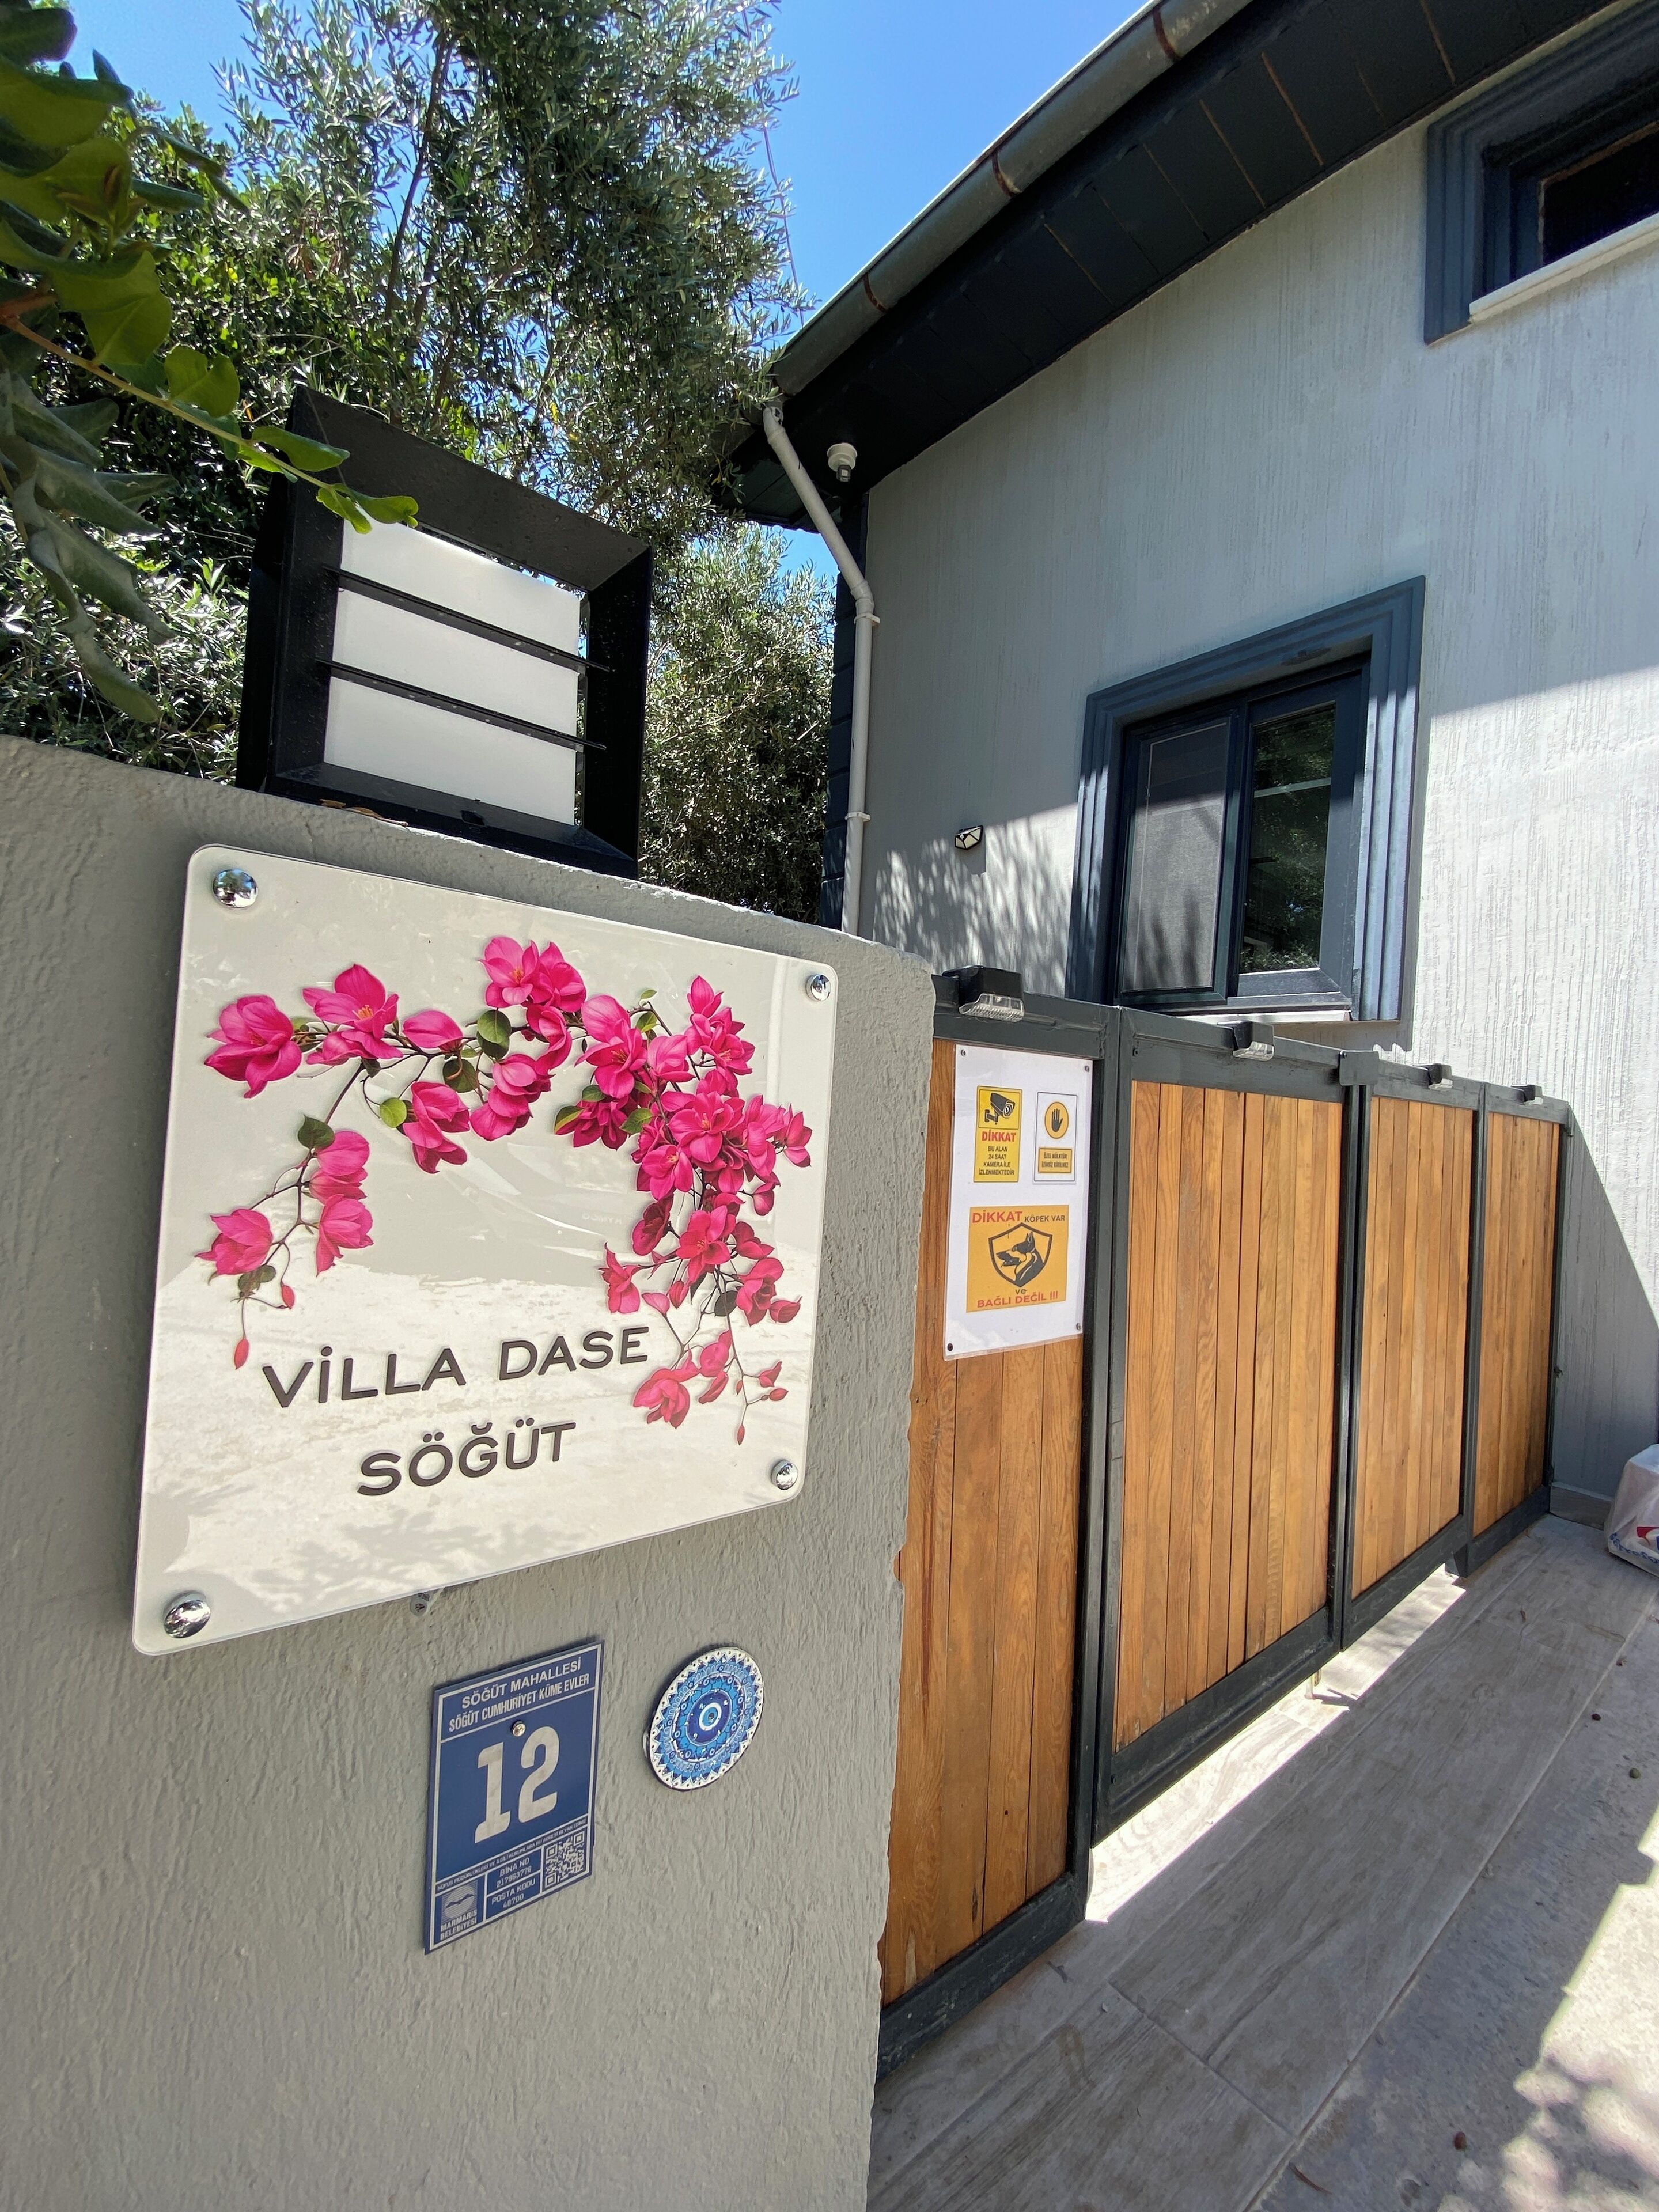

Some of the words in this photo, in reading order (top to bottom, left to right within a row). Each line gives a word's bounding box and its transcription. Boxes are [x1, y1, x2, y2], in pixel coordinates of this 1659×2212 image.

[982, 1130, 1016, 1142] DİKKAT
[972, 1210, 1022, 1223] DİKKAT
[1024, 1214, 1049, 1222] KÖPEK
[977, 1296, 1011, 1308] BAĞLI
[1015, 1291, 1047, 1304] DEĞİL
[499, 1327, 649, 1381] DASE
[357, 1417, 576, 1496] SÖĞÜT
[449, 1710, 479, 1732] SÖĞÜT
[482, 1690, 537, 1721] CUMHURİYET
[539, 1682, 562, 1700] KÜME
[564, 1673, 589, 1692] EVLER
[462, 1683, 507, 1709] SÖĞÜT
[510, 1657, 581, 1692] MAHALLESİ
[475, 1726, 559, 1843] 12
[500, 1863, 517, 1877] BİNA
[520, 1857, 529, 1867] NO
[492, 1888, 515, 1905] POSTA
[517, 1878, 536, 1892] KODU
